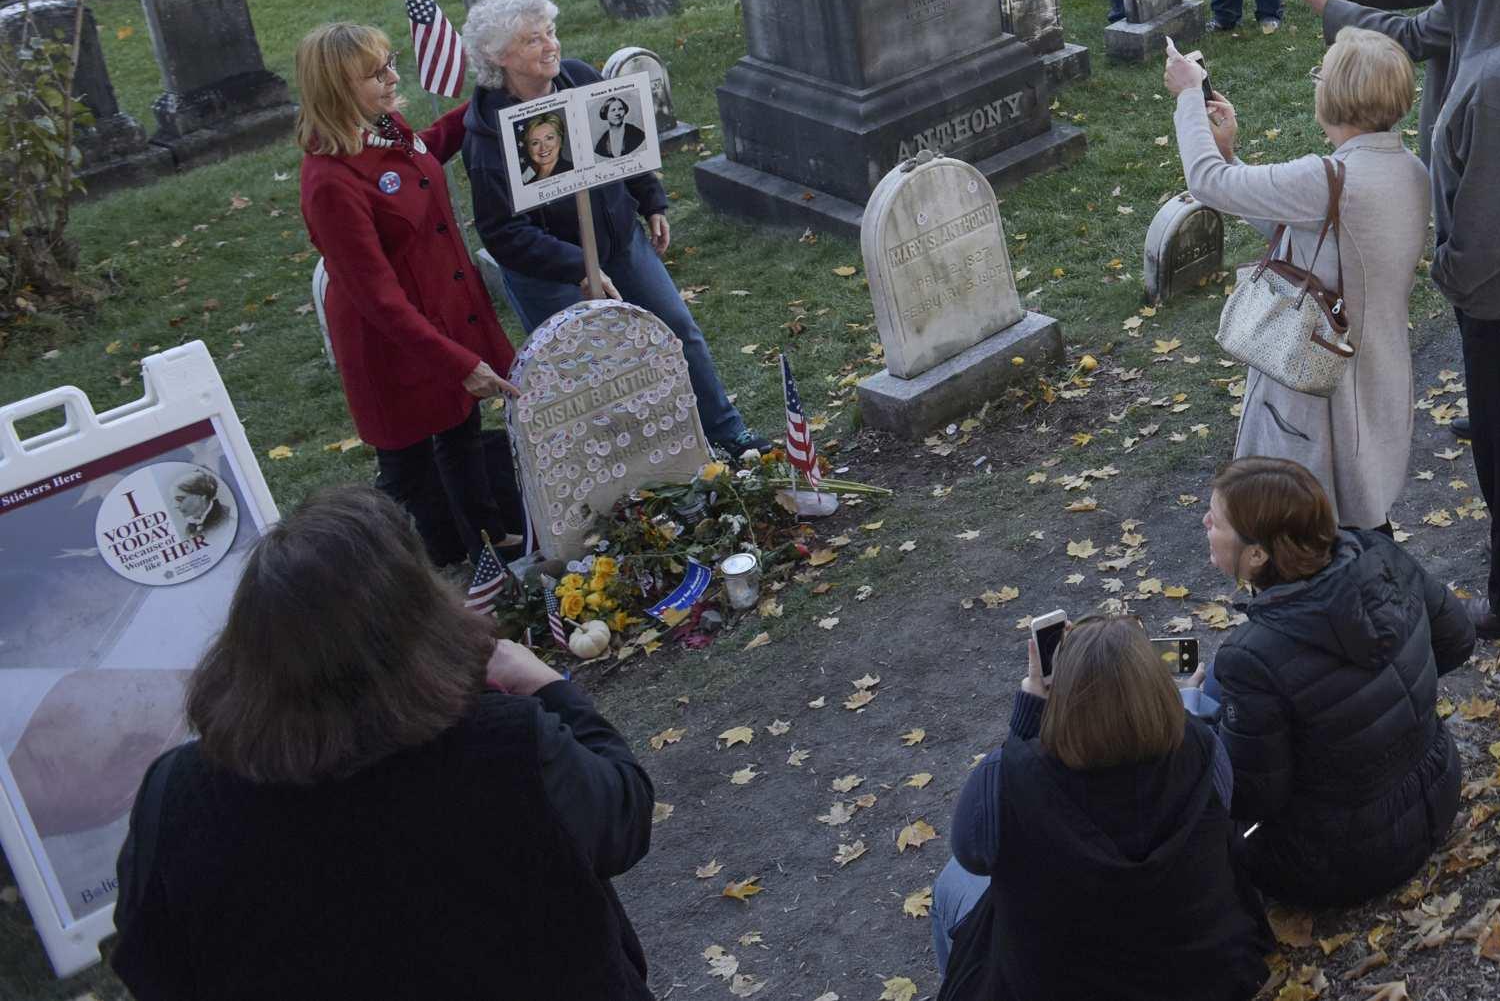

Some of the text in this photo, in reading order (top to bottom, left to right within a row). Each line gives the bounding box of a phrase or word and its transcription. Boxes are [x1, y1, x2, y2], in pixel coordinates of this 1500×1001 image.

[590, 89, 608, 98] Susan
[898, 90, 1024, 162] ANTHONY
[594, 172, 616, 183] New
[620, 163, 645, 175] York
[888, 238, 924, 267] MARY
[942, 205, 993, 242] ANTHONY
[533, 392, 588, 432] SUSAN
[1, 470, 83, 507] Stickers Here
[121, 489, 145, 519] I
[103, 510, 168, 543] VOTED
[109, 522, 171, 558] TODAY
[119, 542, 164, 565] Because
[165, 534, 177, 546] of
[124, 553, 160, 572] Women
[160, 534, 211, 564] HER
[144, 560, 162, 573] like
